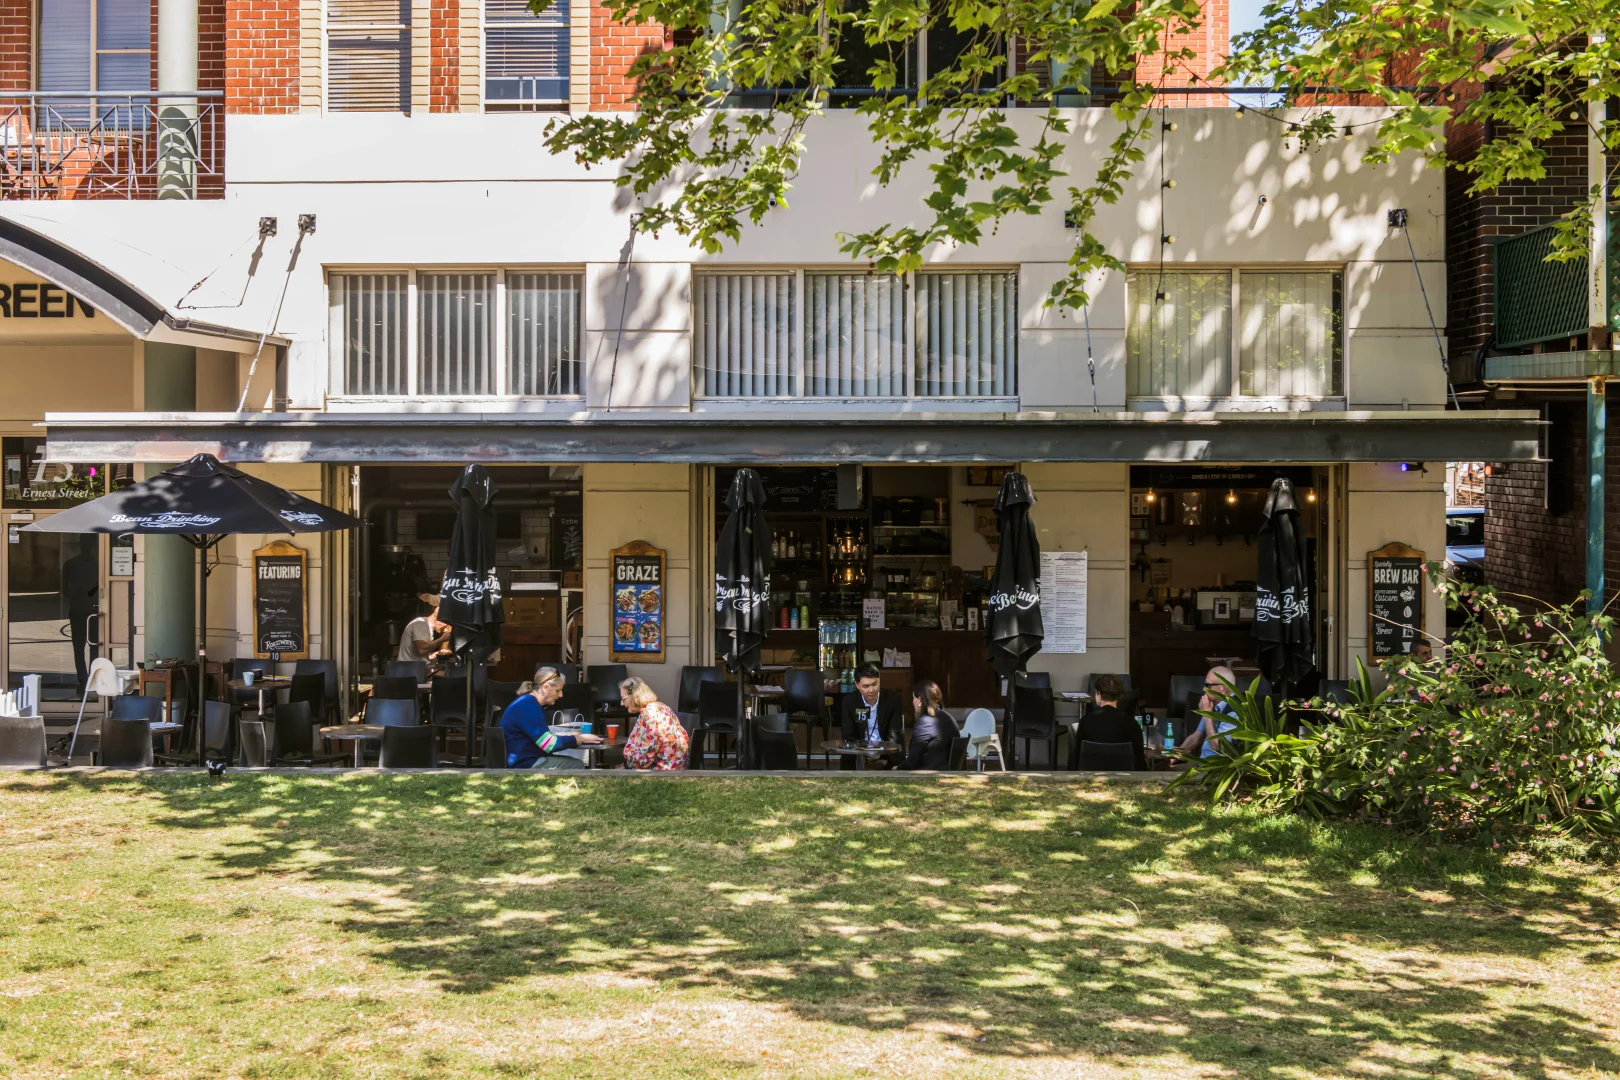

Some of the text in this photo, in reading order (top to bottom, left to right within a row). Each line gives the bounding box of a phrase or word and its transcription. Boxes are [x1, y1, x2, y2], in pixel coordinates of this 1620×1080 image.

[22, 487, 89, 498] Ernest Street
[109, 514, 222, 525] Bean Drinking
[259, 565, 301, 580] FEATURING
[617, 565, 659, 581] GRAZE
[1374, 568, 1419, 584] BREW BAR
[1374, 593, 1399, 602] Cascara
[1375, 627, 1393, 635] Brew
[271, 652, 280, 661] 10
[857, 711, 867, 721] 15
[1145, 714, 1151, 724] 9
